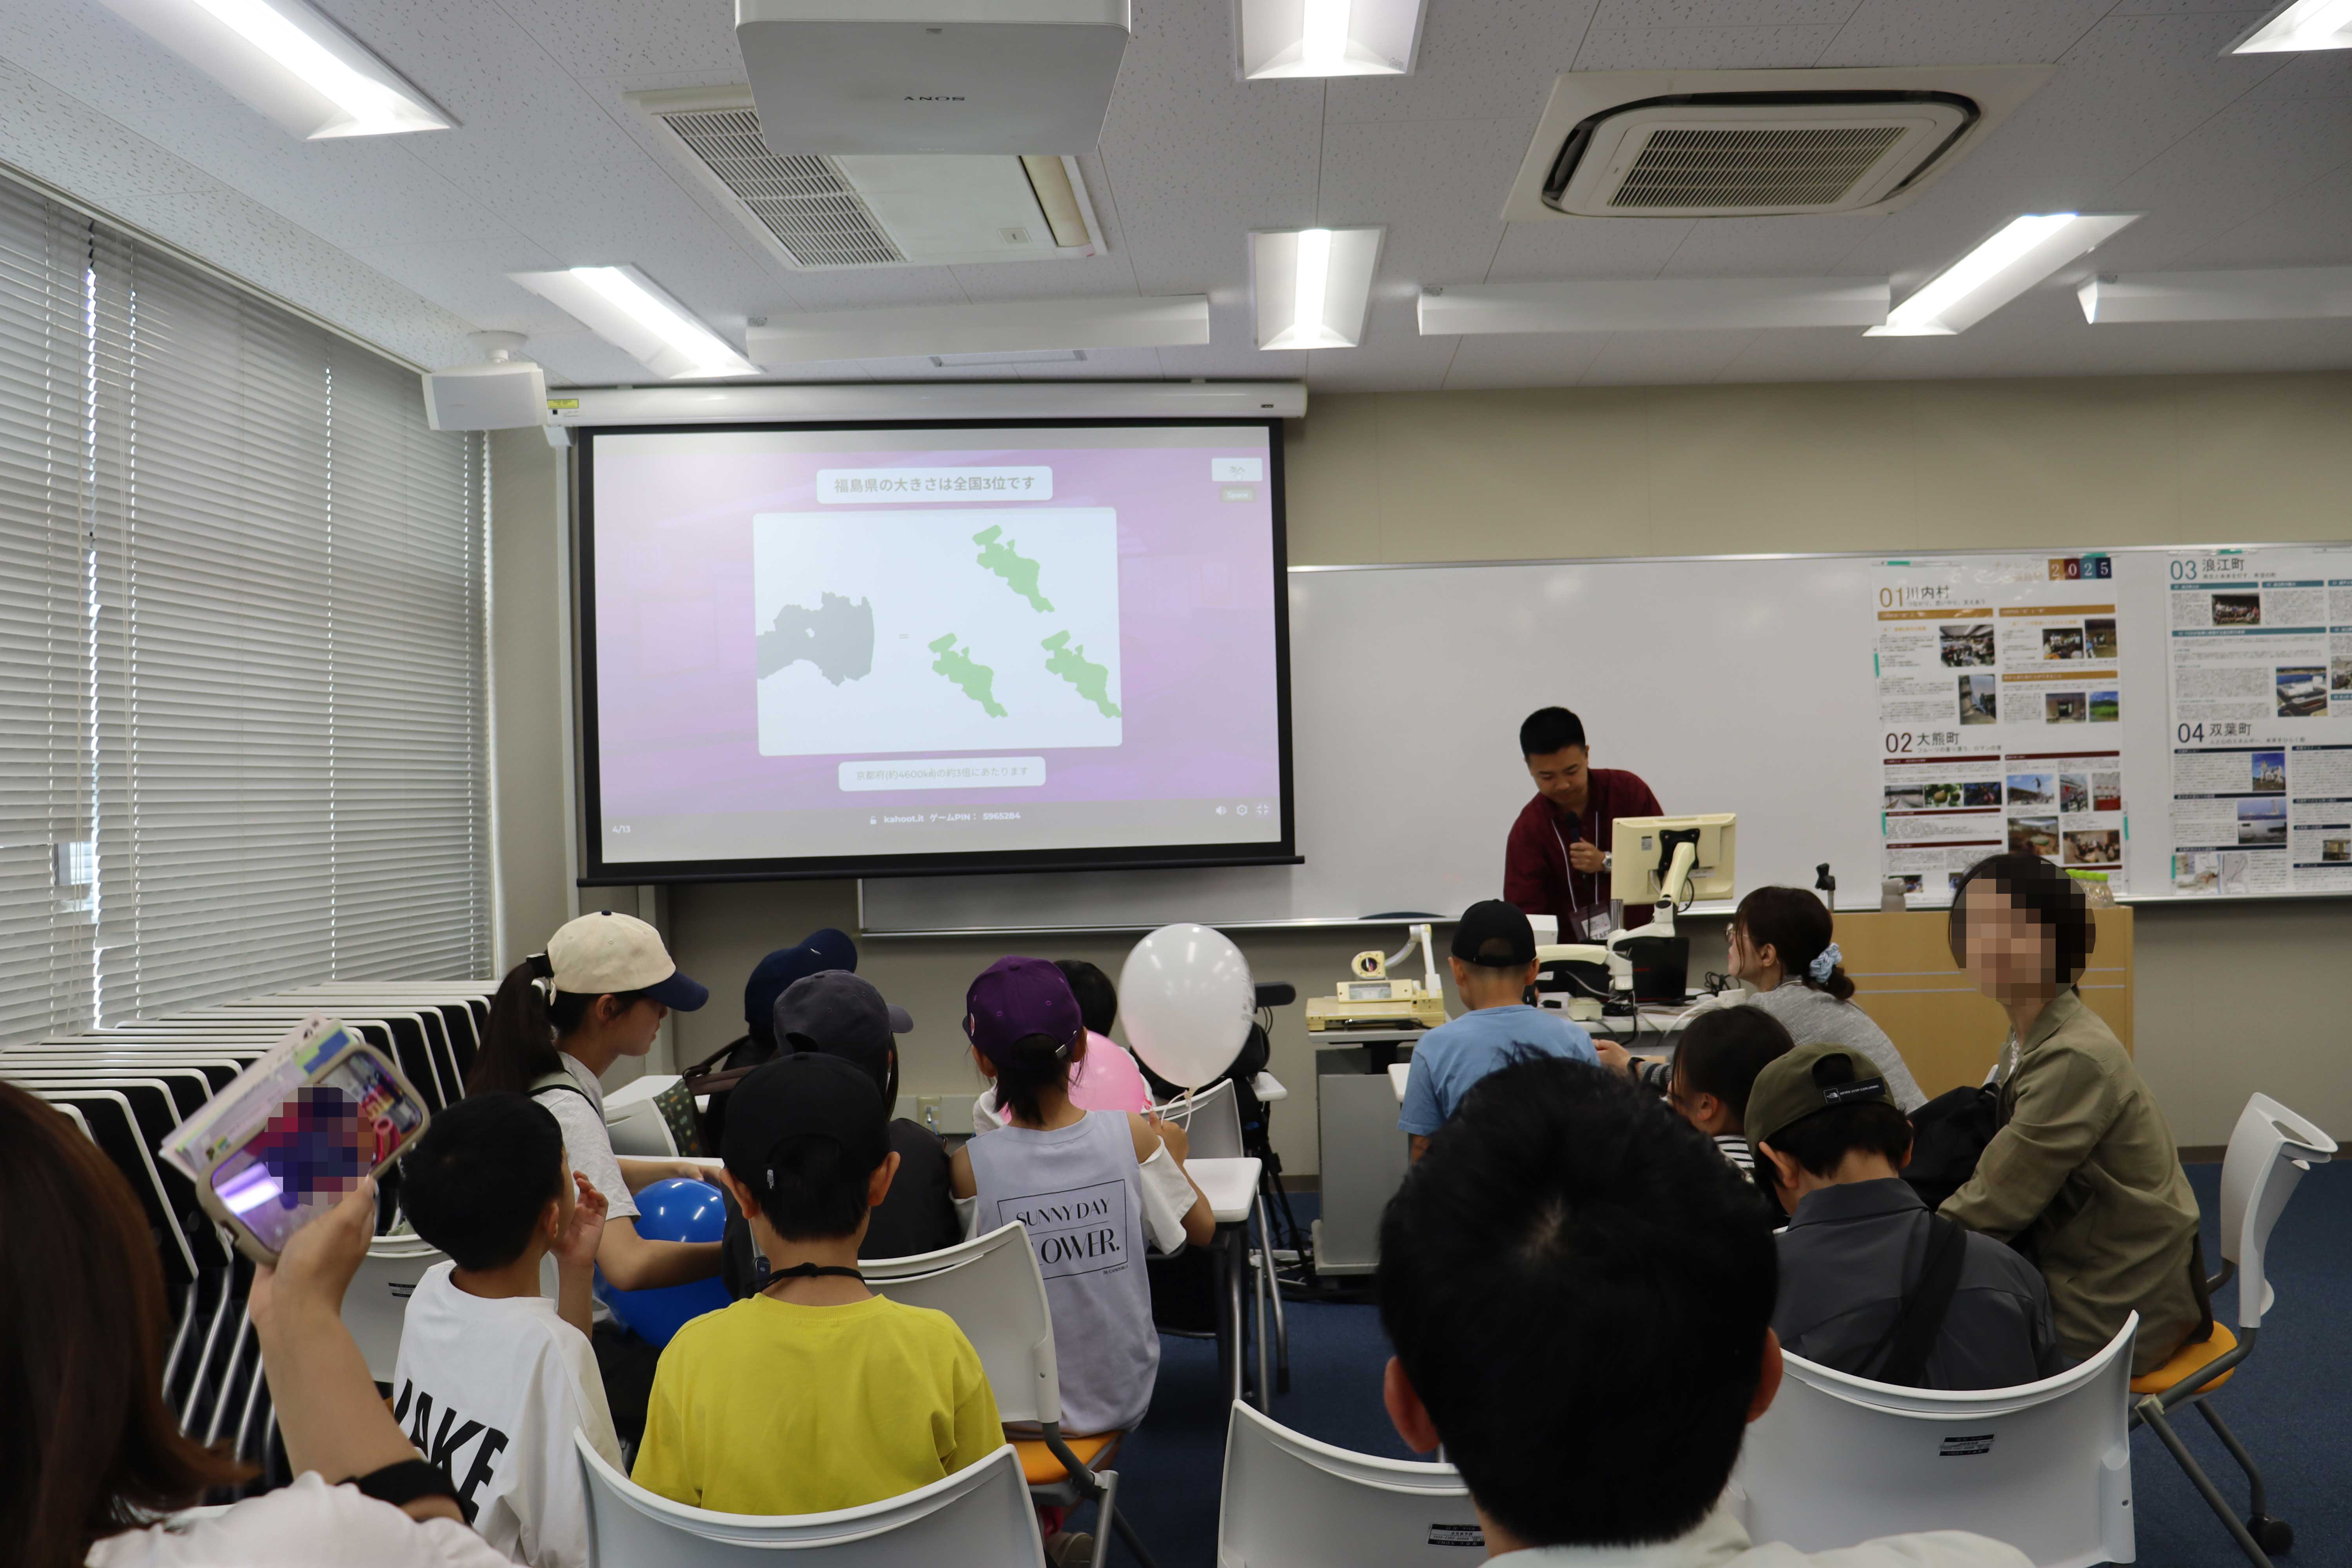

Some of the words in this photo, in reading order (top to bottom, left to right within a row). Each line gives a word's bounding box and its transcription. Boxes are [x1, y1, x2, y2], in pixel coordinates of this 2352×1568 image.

[834, 475, 1035, 493] 福島県の大きさは全国3位です
[2051, 562, 2109, 577] 2025
[2170, 560, 2197, 580] 03
[2202, 558, 2245, 572] 浪江町
[1880, 588, 1903, 608] 01
[1906, 585, 1950, 599] 川内村
[1886, 732, 1913, 753] 02
[1917, 731, 1959, 746] 大熊町
[2178, 723, 2204, 743] 04
[2209, 722, 2252, 737] 双葉町
[612, 824, 631, 834] 4/13
[884, 814, 924, 823] kahoot.it
[1016, 1205, 1073, 1227] SUNNY
[1077, 1197, 1110, 1219] DAY
[1031, 1229, 1120, 1265] OWER.
